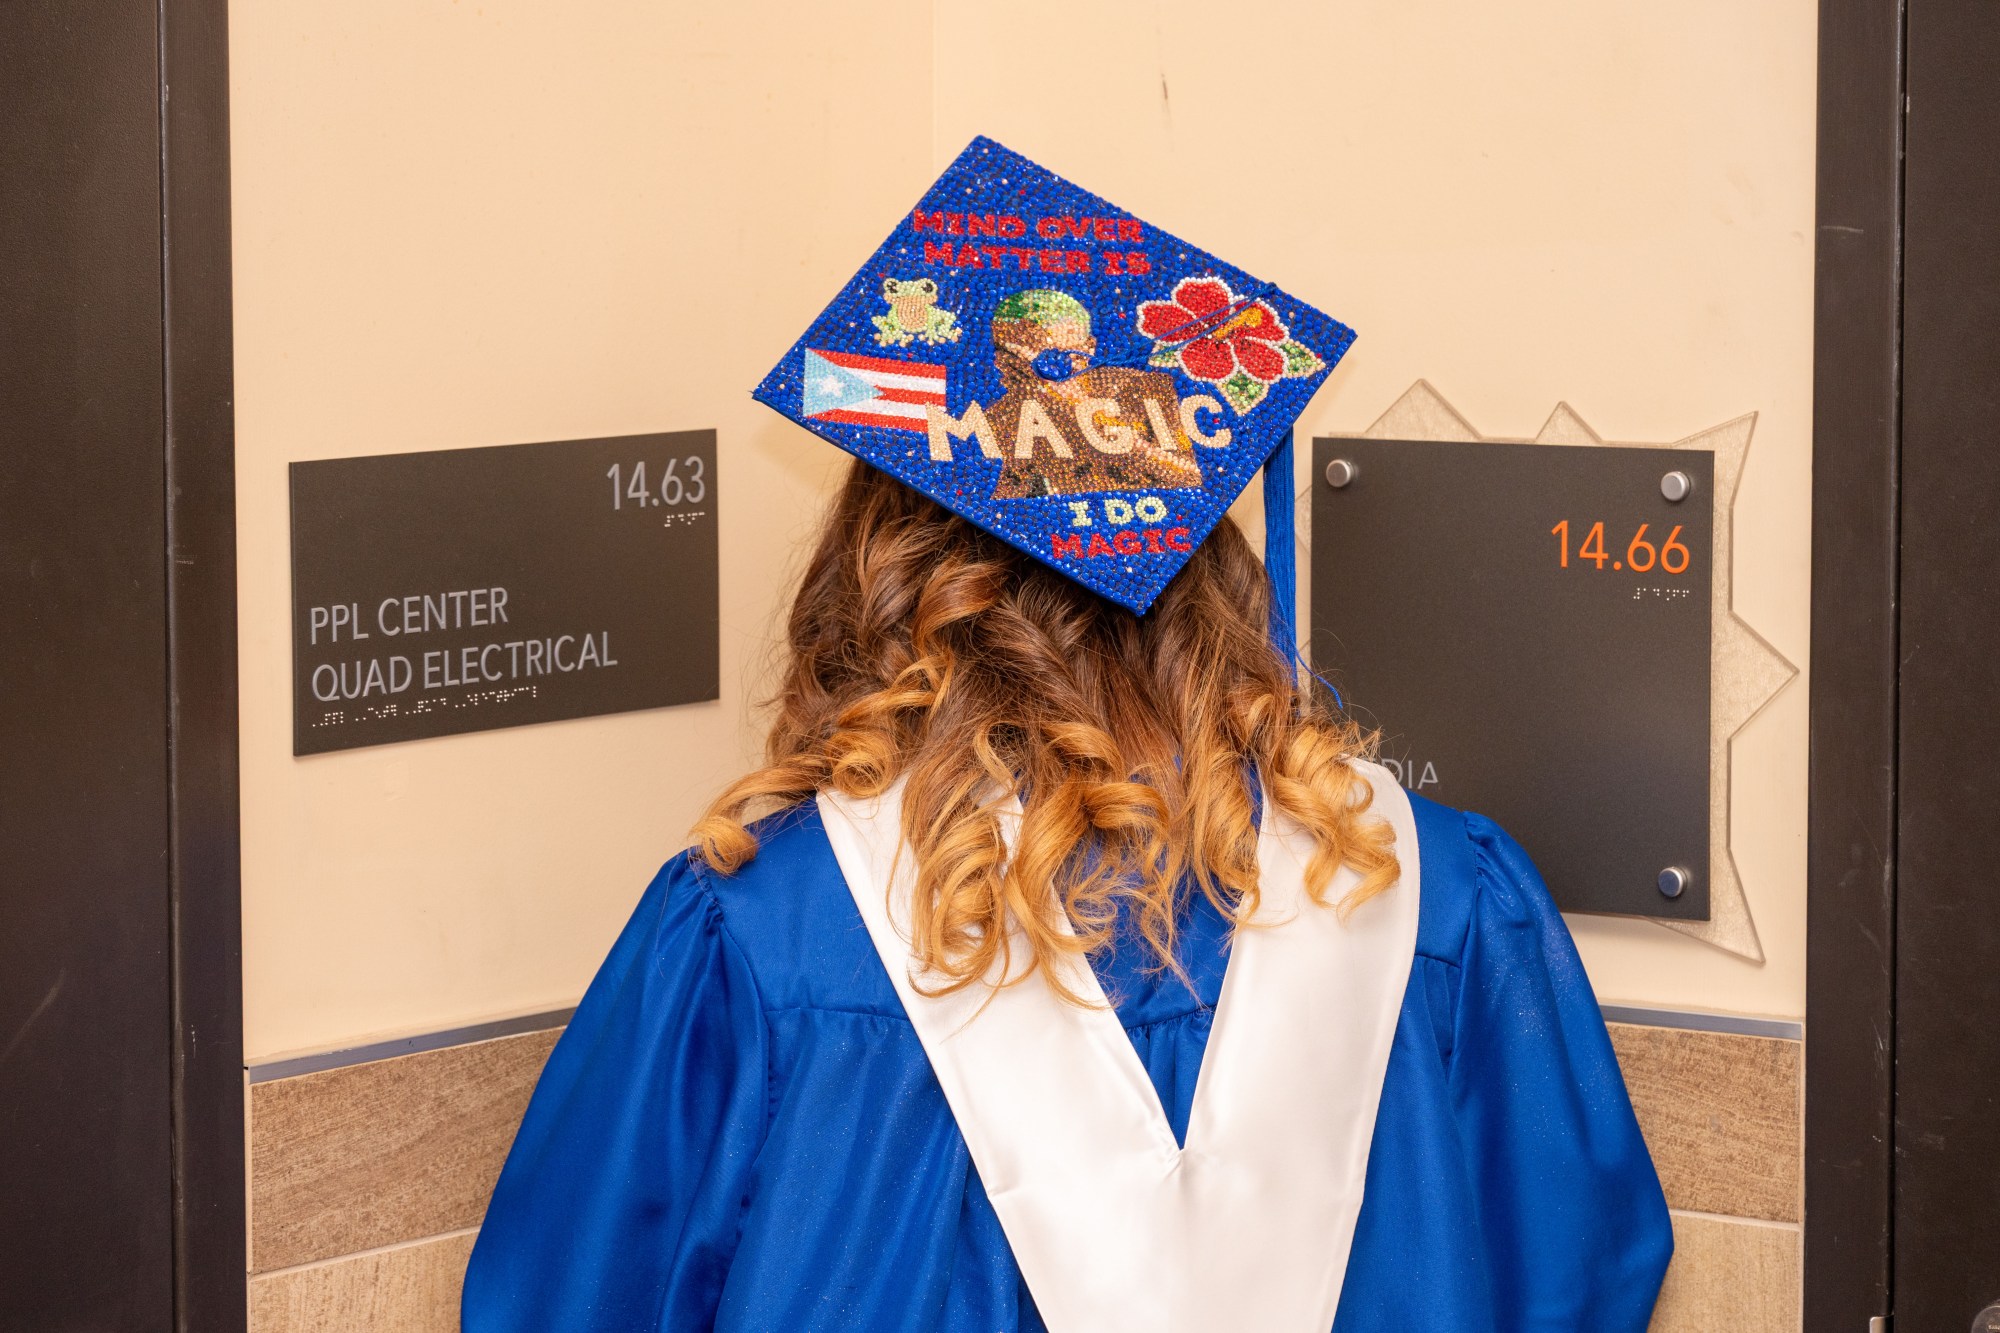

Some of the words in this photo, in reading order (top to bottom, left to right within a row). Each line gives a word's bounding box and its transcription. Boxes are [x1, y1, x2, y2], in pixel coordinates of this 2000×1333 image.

[913, 209, 1026, 238] MIND
[1037, 216, 1144, 243] OVER
[923, 241, 1091, 273] MATTER
[1103, 251, 1152, 275] IS
[926, 395, 1232, 461] MAGIC
[606, 455, 706, 510] 14.63
[1068, 501, 1093, 526] I
[1104, 496, 1167, 524] DO
[1051, 527, 1192, 559] MAGIC
[1551, 520, 1690, 574] 14.66
[310, 602, 369, 645] PPL
[378, 587, 509, 637] CENTER
[311, 655, 413, 702] QUAD
[423, 631, 618, 690] ELECTRICAL
[1361, 757, 1439, 790] DIA
